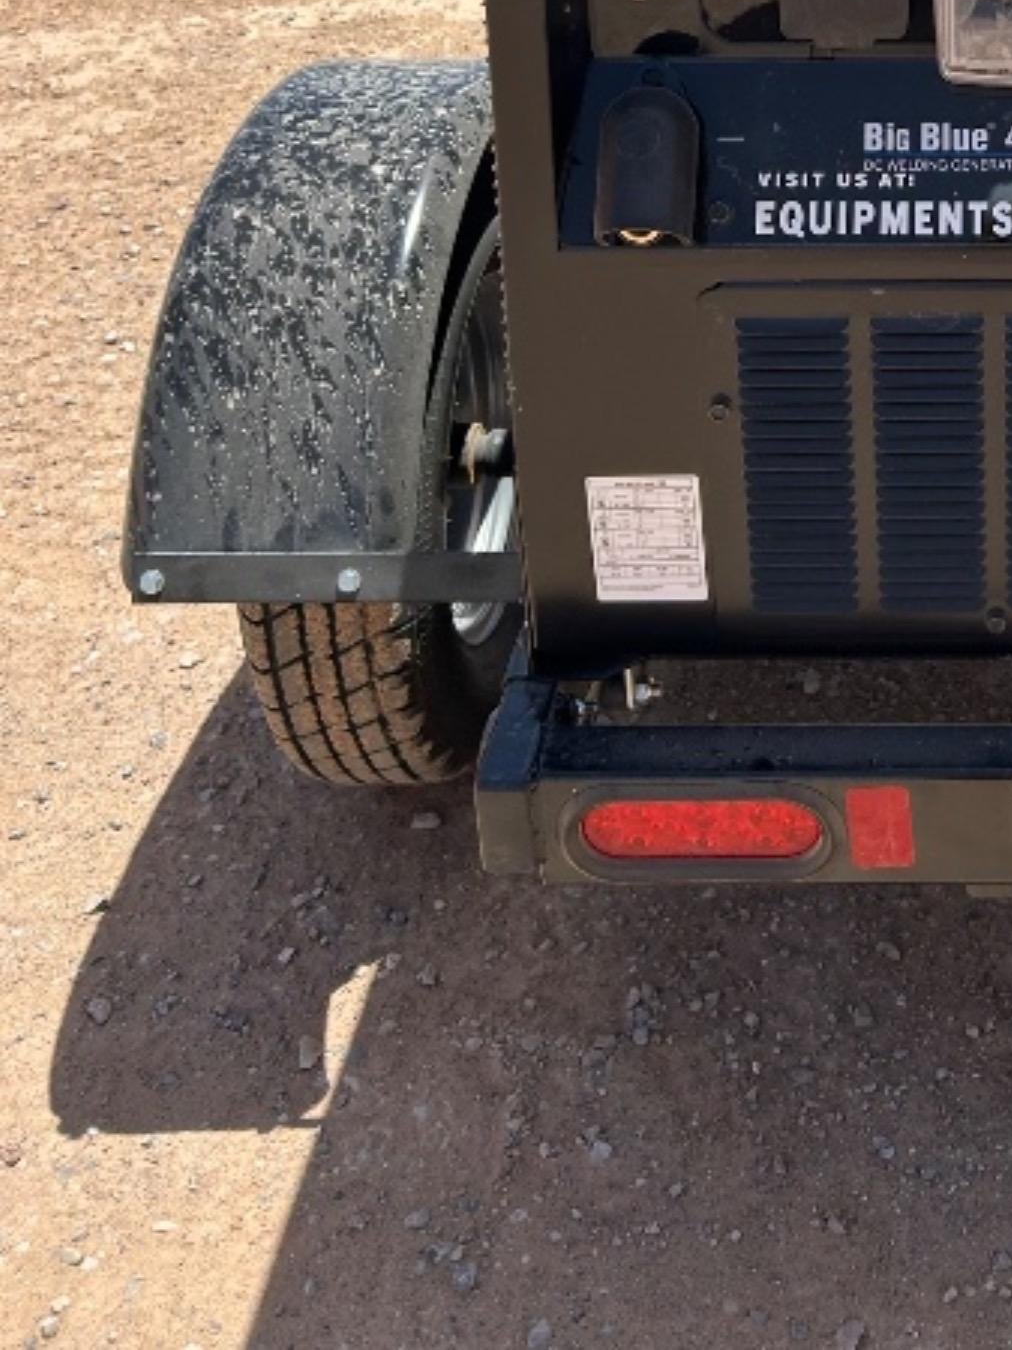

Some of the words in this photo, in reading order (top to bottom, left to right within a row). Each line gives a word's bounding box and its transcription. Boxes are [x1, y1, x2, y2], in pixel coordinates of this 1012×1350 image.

[920, 121, 989, 151] Blue
[886, 158, 948, 172] WELDING
[758, 172, 825, 188] VISIT
[835, 172, 869, 188] US
